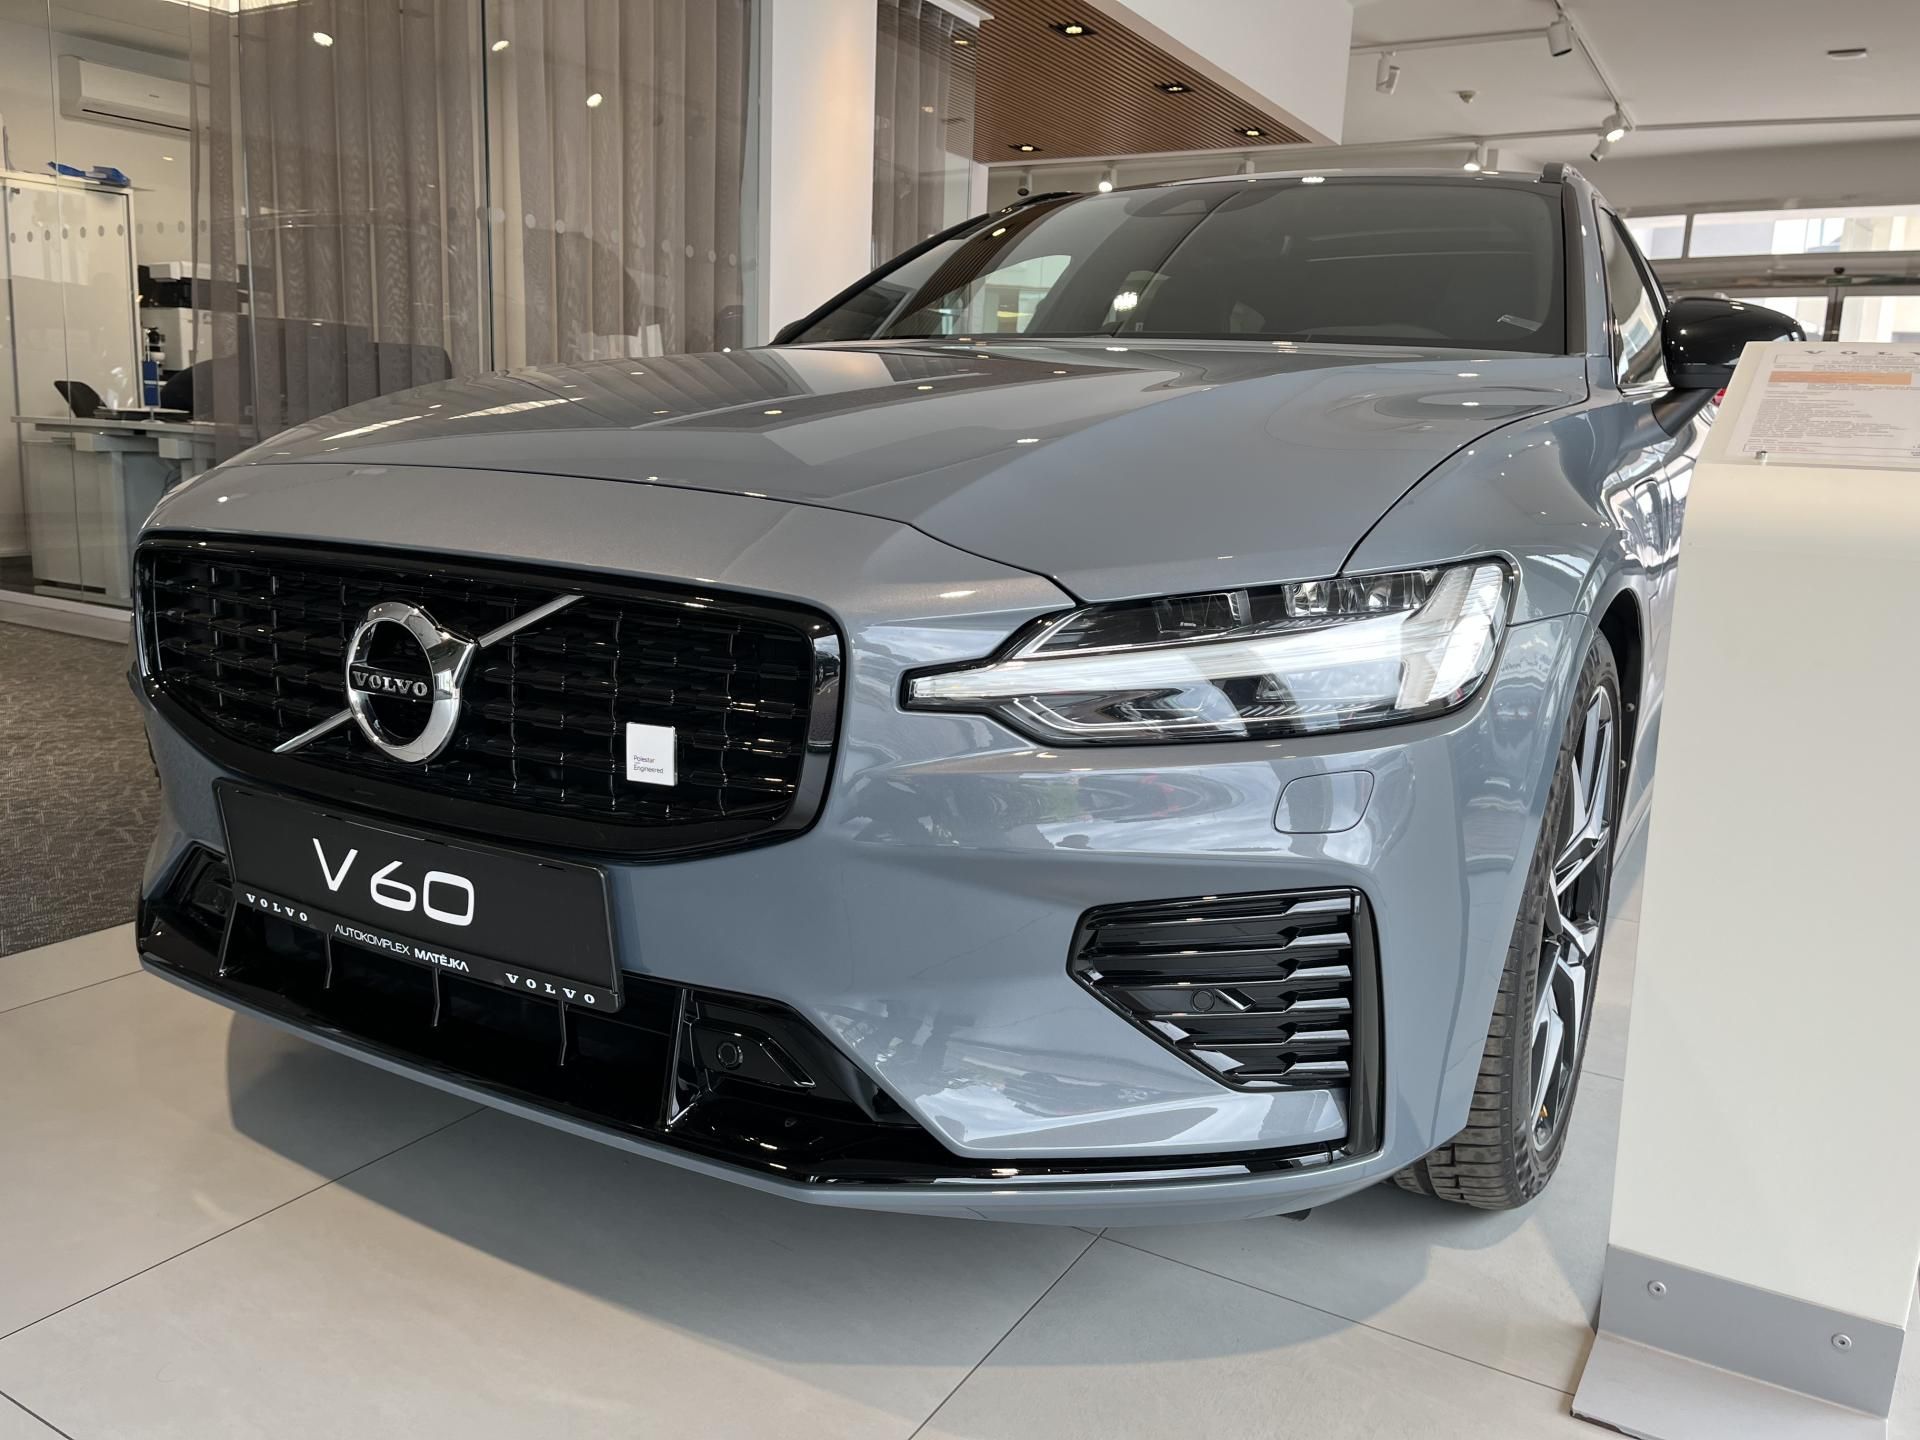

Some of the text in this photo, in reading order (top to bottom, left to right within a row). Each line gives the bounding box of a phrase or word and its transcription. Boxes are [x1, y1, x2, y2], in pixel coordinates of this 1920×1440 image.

[352, 670, 428, 697] VOLVO
[312, 837, 475, 927] V 60
[246, 892, 308, 922] VOLVO
[334, 923, 411, 956] AUTOKOMPLEX
[505, 972, 596, 1004] VOLVO
